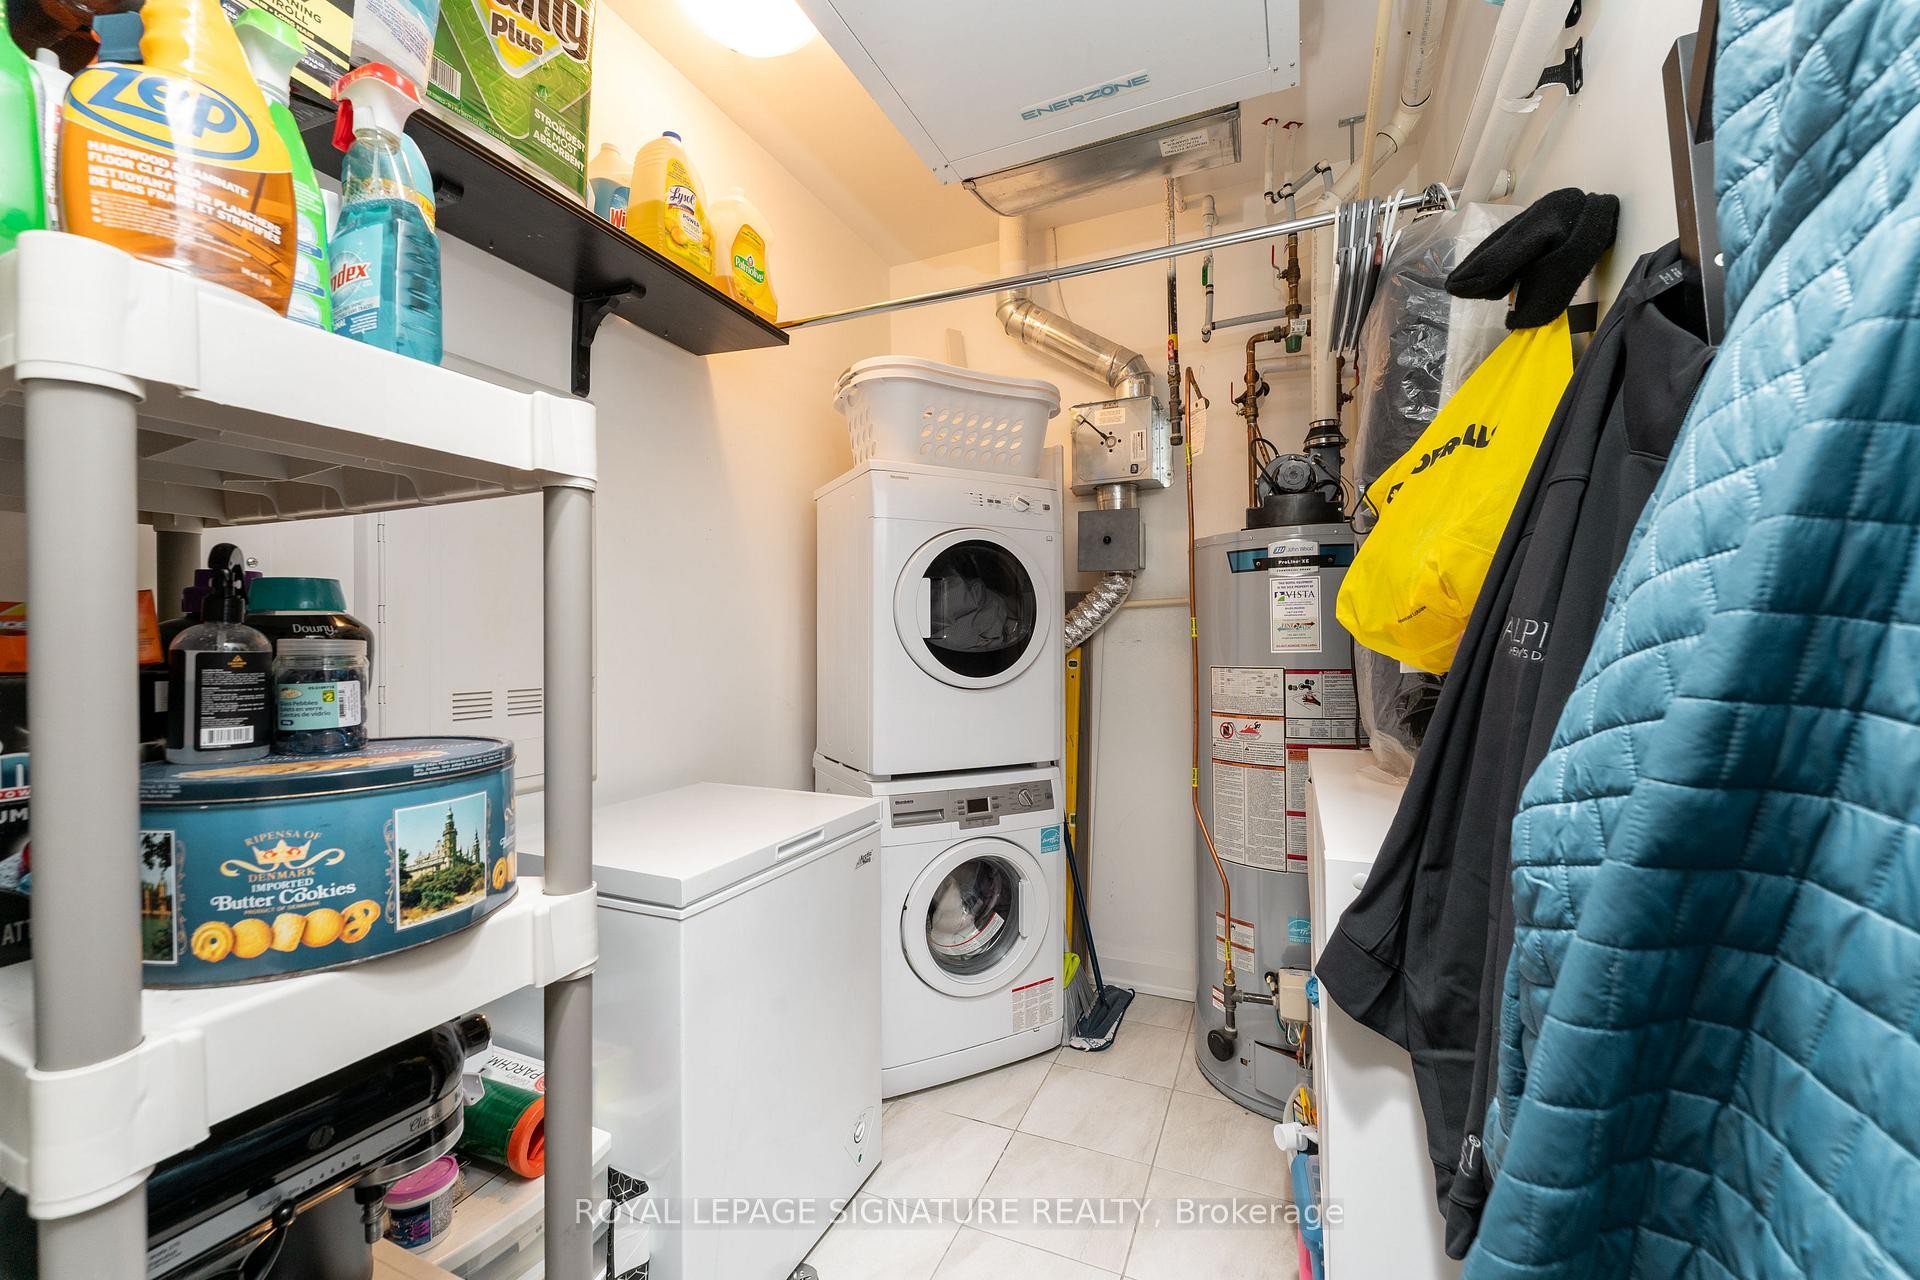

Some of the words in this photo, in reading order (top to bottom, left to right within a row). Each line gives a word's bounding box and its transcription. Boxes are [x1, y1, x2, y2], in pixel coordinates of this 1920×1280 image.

[491, 12, 544, 56] Plus
[1021, 75, 1150, 121] ENERZONE
[534, 108, 586, 153] STRONGEST
[543, 126, 552, 137] &
[552, 132, 578, 156] MOST
[86, 139, 170, 168] HARDWOOD
[87, 150, 136, 171] FLOOR
[533, 130, 585, 172] ABSORBENT
[88, 174, 110, 188] DE
[111, 179, 146, 196] BOIS
[196, 200, 215, 215] ET
[88, 163, 172, 193] NETTOYANT
[213, 194, 282, 236] PLANCHERS
[669, 187, 695, 205] Lysol
[331, 262, 369, 293] ndex
[735, 256, 765, 282] Palmolive
[1286, 590, 1315, 598] VISTA
[292, 623, 335, 636] Downy
[244, 829, 301, 847] RIPENSA
[303, 830, 322, 841] OF
[248, 867, 317, 883] DENMARK
[251, 877, 315, 893] IMPORTED
[210, 894, 276, 912] Butter
[278, 882, 357, 905] Cookies
[488, 1055, 545, 1080] PARCHM
[409, 1110, 441, 1132] Classic
